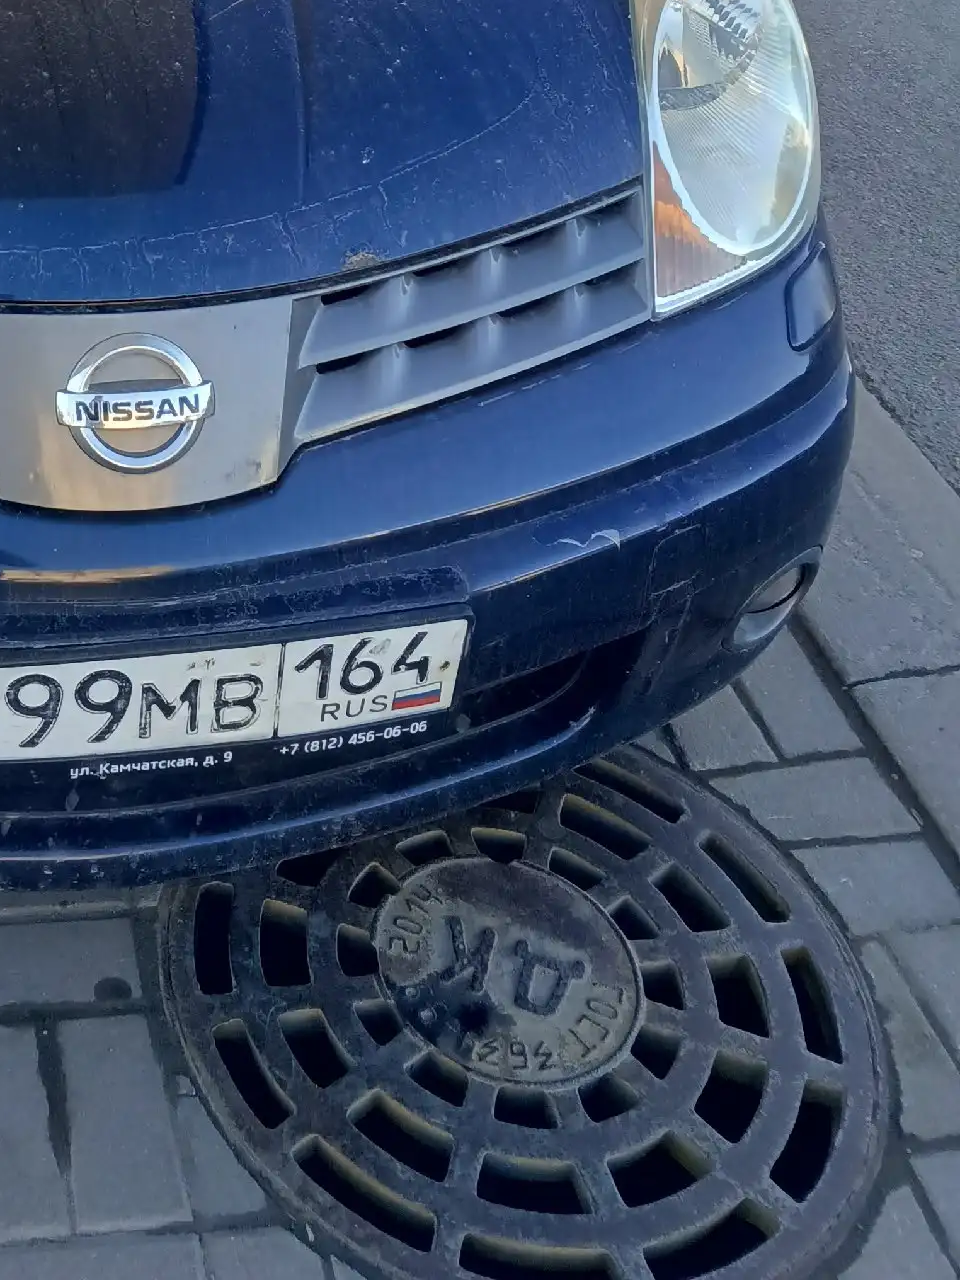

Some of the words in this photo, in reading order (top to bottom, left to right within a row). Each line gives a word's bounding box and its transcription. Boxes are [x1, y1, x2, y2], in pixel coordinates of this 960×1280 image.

[75, 394, 200, 422] NISSAN
[294, 631, 430, 700] 164
[320, 694, 389, 722] RUS
[279, 743, 300, 756] +7
[303, 736, 343, 754] (812)
[347, 720, 428, 745] 456-06-06
[69, 765, 94, 780] ул.
[99, 757, 199, 777] Камчатская,
[202, 754, 219, 768] д.
[223, 751, 233, 763] 9
